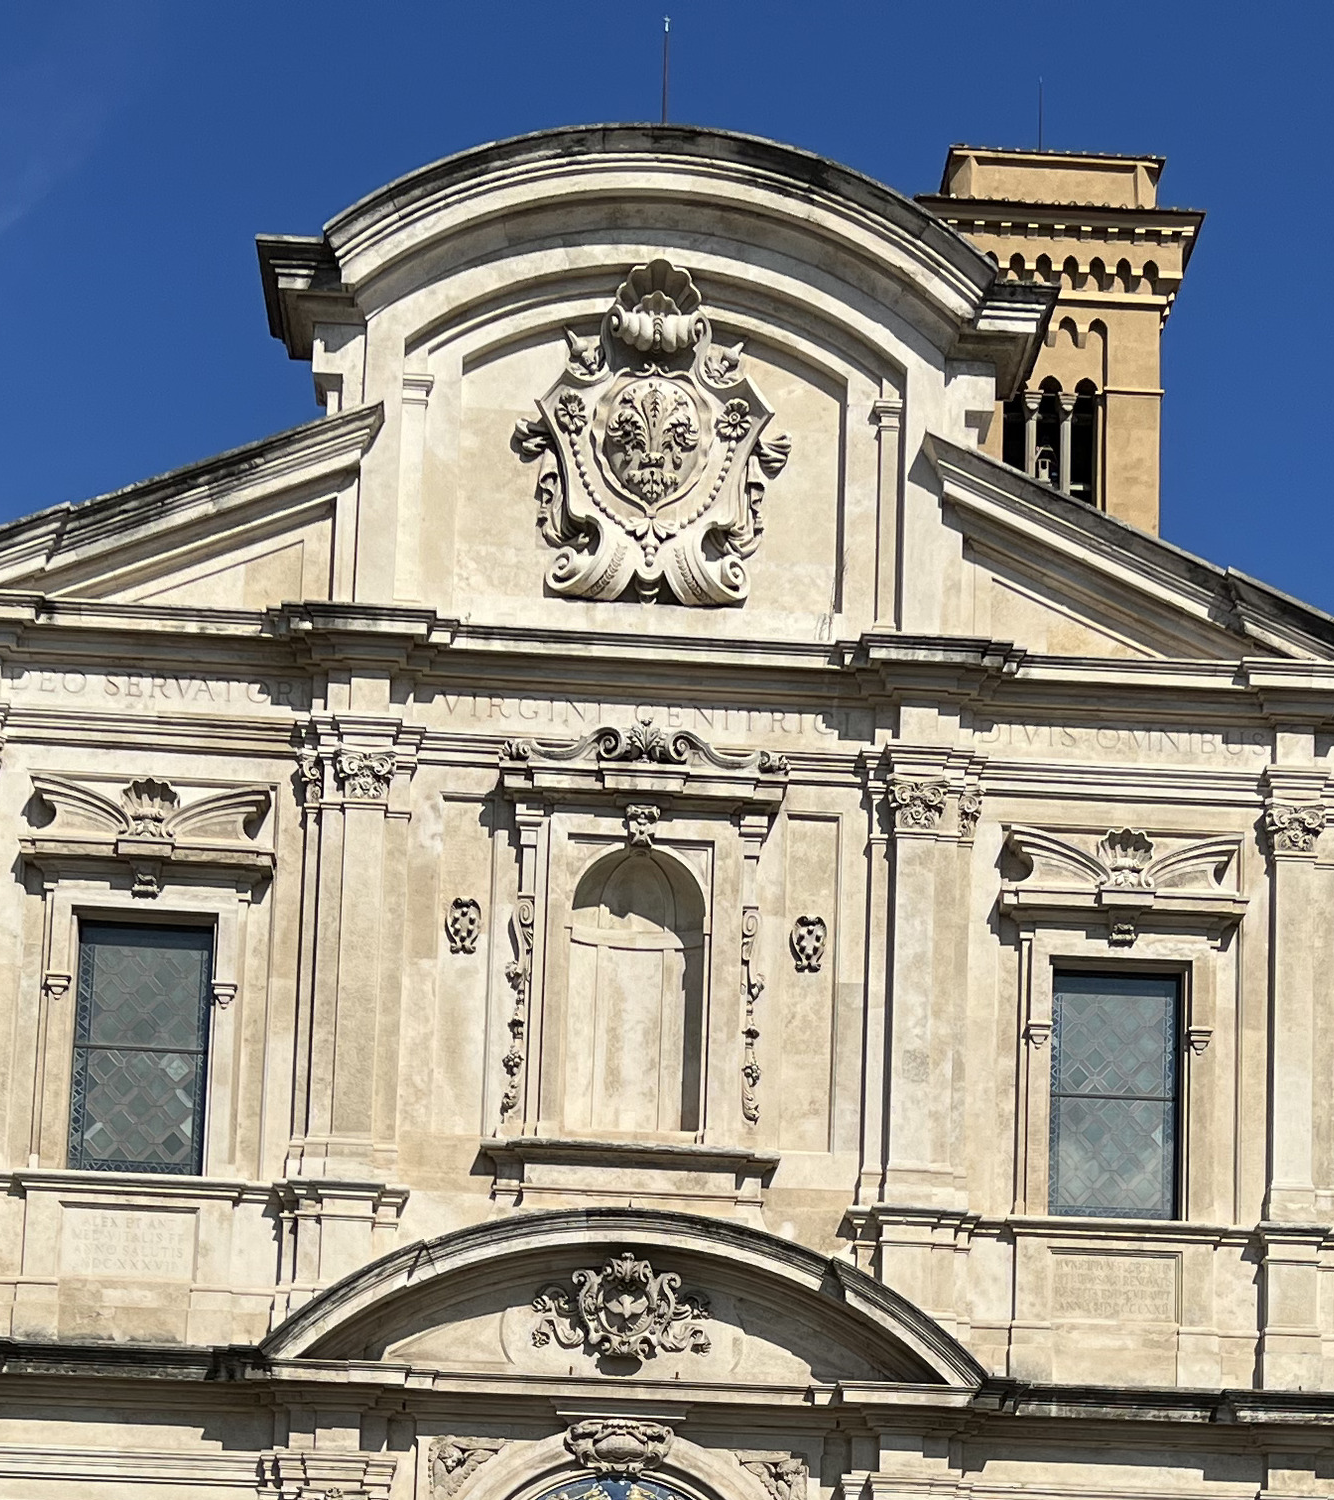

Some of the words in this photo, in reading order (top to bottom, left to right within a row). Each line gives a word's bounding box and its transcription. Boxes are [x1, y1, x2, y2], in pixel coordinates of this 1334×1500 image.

[9, 666, 87, 694] DEO
[104, 670, 308, 707] SERVATORI
[439, 690, 602, 725] VIRGINI
[980, 718, 1077, 748] DIVIS
[1095, 725, 1266, 757] OMNIBUS
